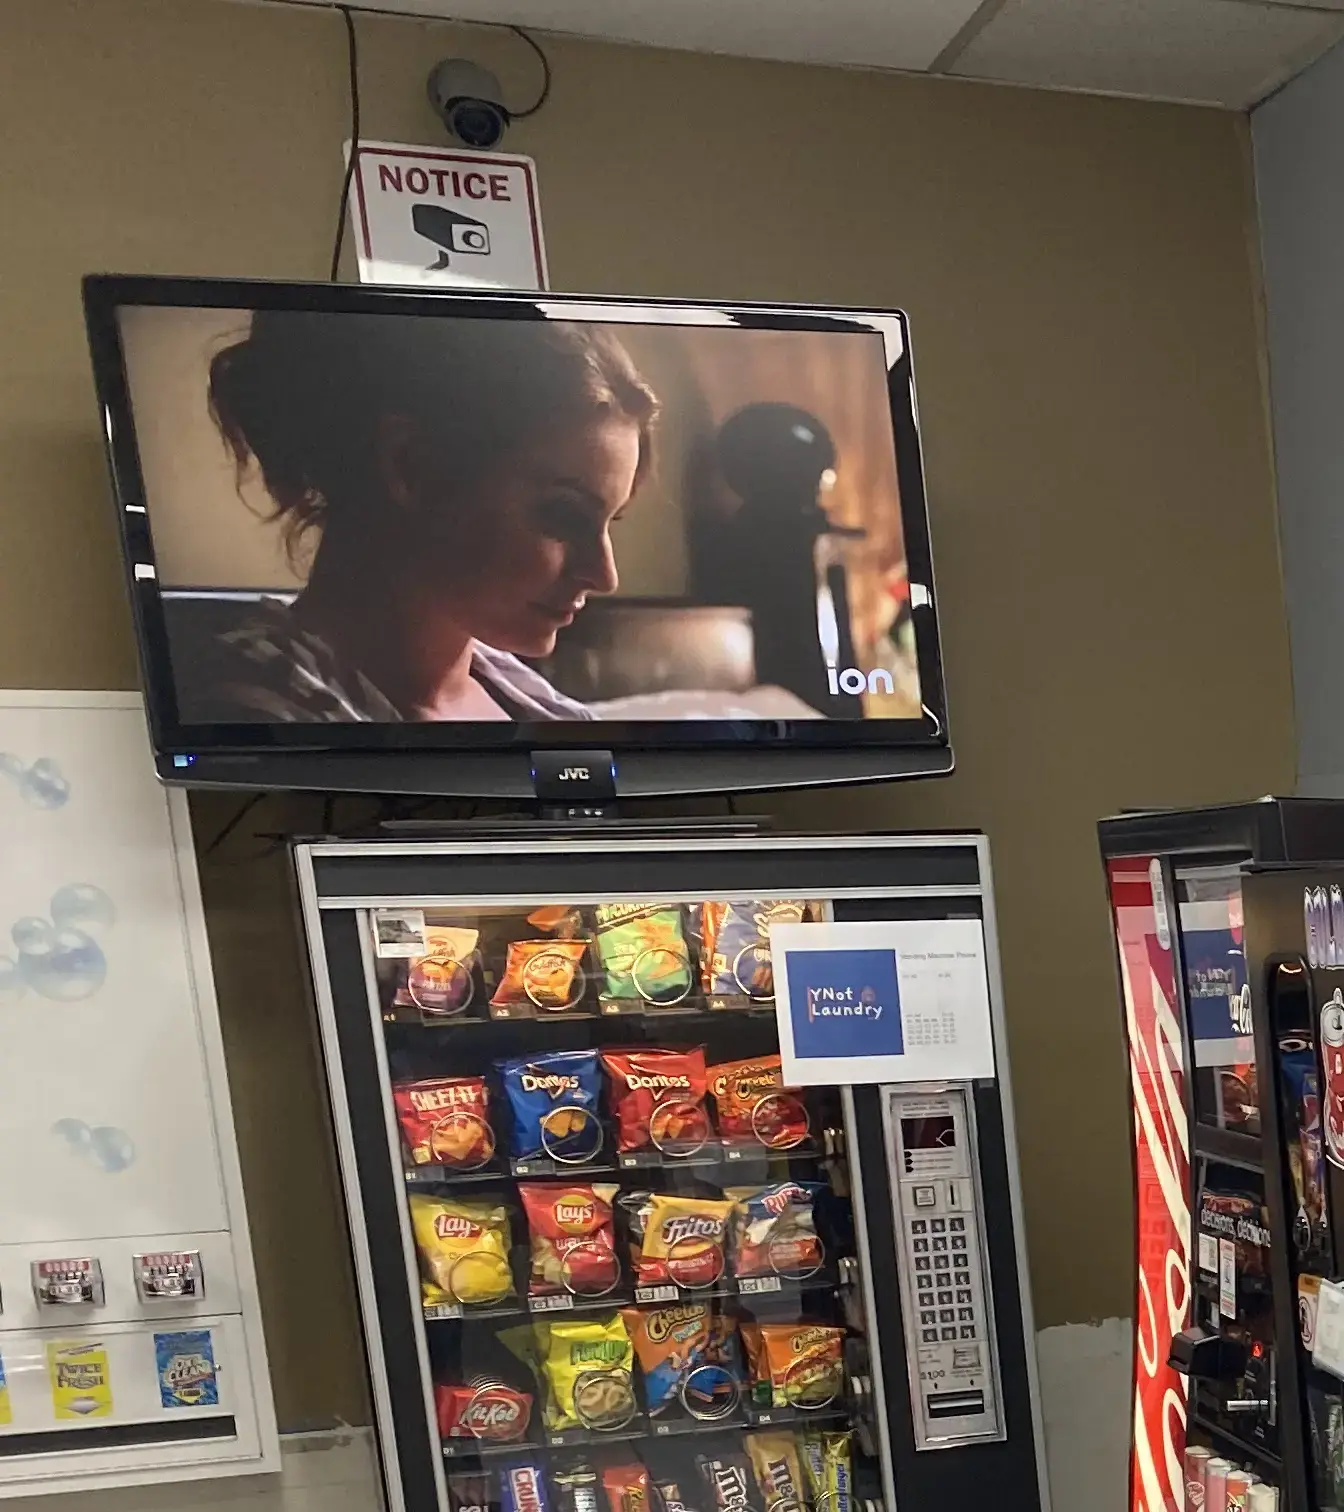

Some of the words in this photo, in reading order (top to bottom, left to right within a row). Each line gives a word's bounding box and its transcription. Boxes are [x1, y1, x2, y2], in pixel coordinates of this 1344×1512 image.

[378, 164, 511, 202] NOTICE
[828, 666, 894, 695] ion
[558, 767, 589, 781] JVC
[811, 986, 853, 1001] YNot
[811, 1001, 883, 1021] Laundry
[522, 1074, 580, 1092] Doritos
[625, 1074, 690, 1091] Doritos
[663, 1215, 724, 1244] Fritos
[56, 1362, 101, 1375] TWICE
[57, 1375, 104, 1389] FRESH
